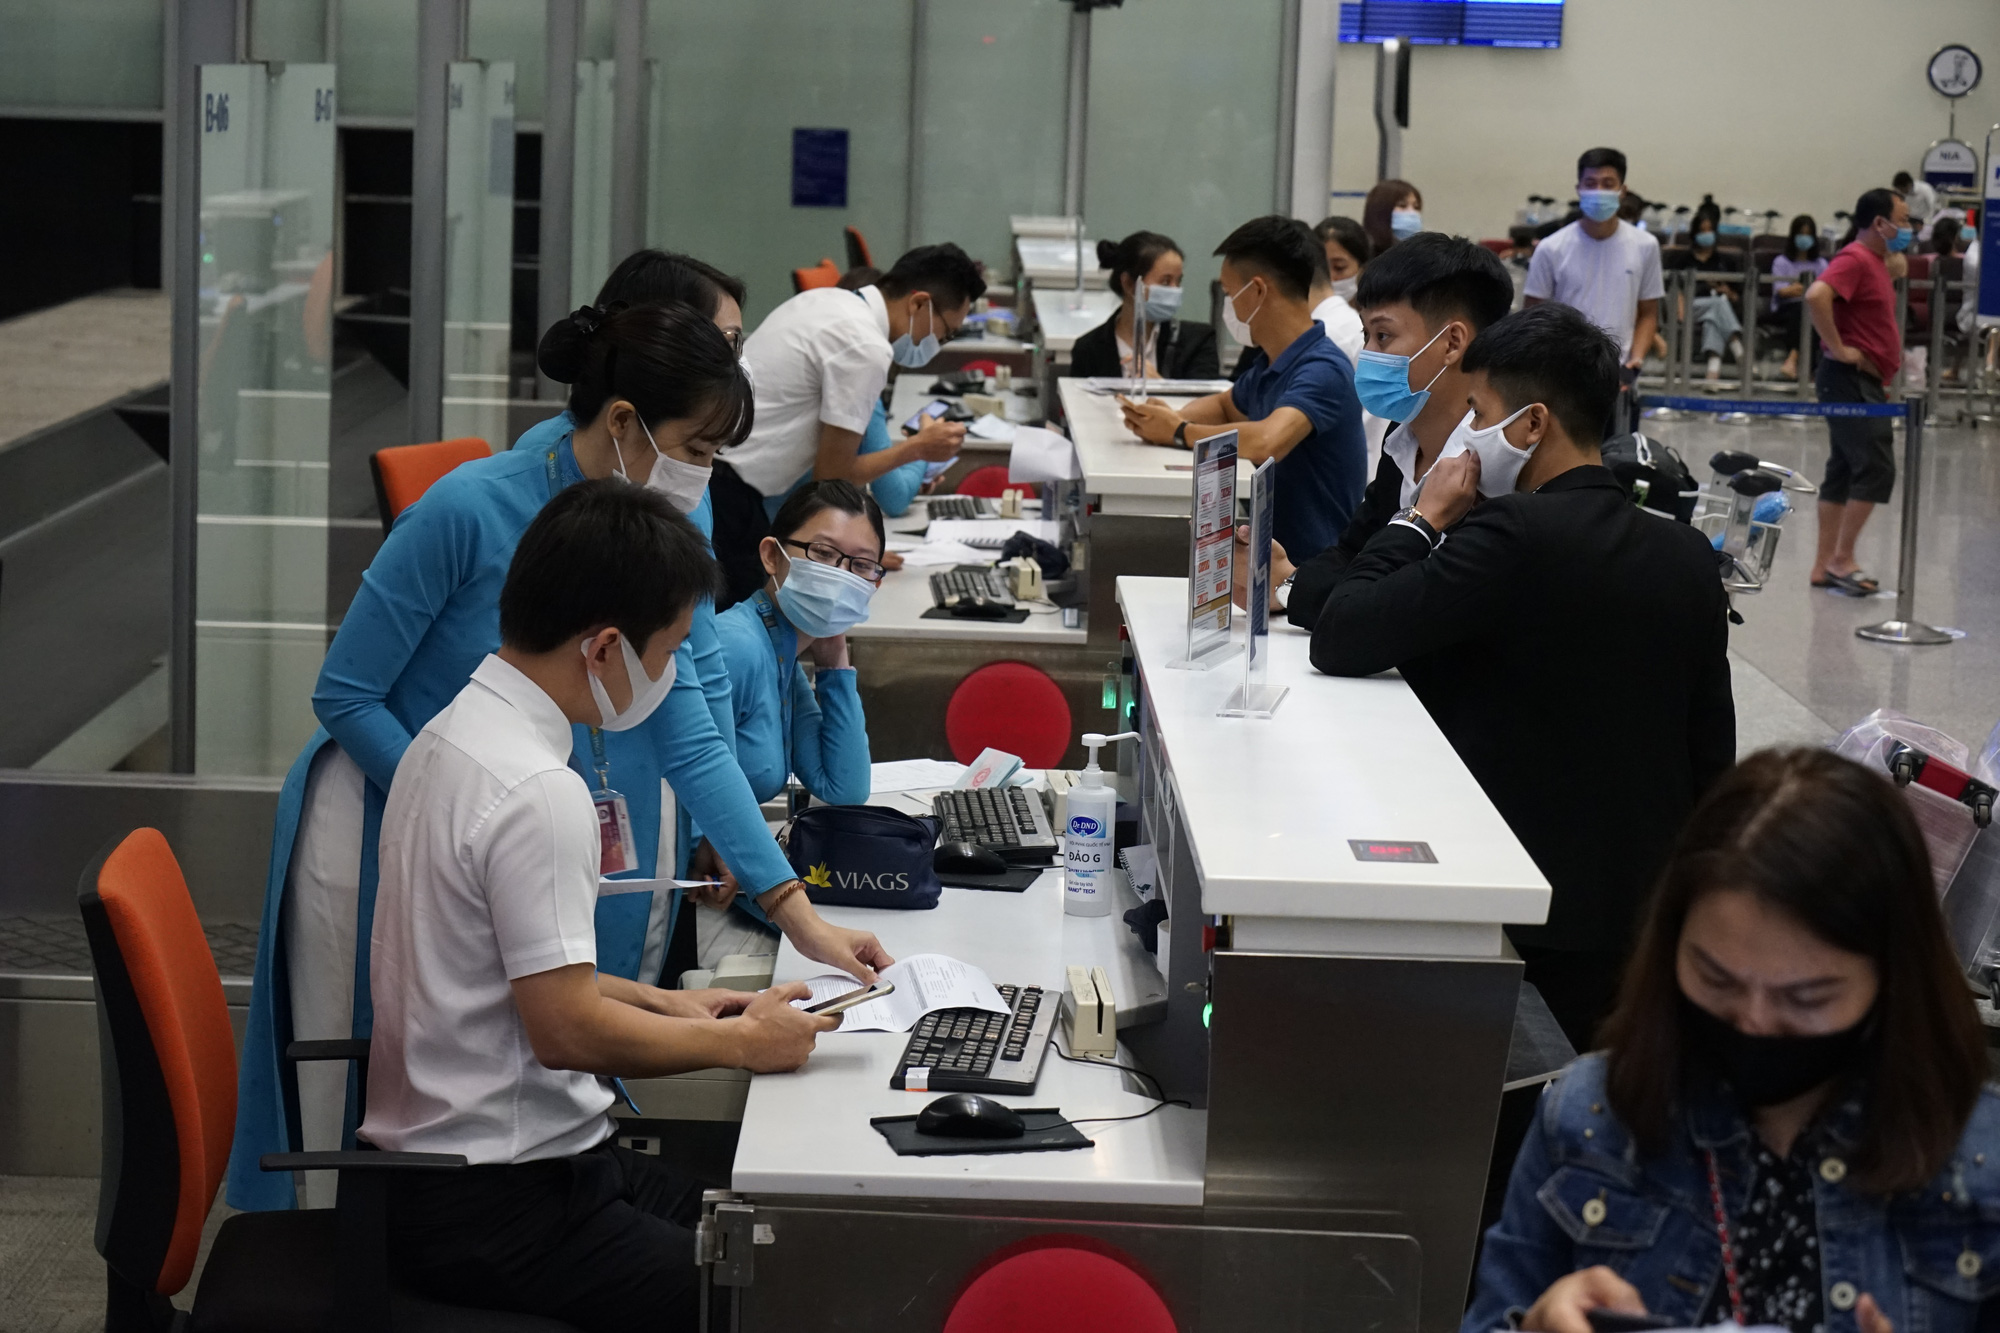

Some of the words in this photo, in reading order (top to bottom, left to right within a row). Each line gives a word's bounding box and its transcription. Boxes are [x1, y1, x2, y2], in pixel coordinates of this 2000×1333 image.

[1069, 850, 1090, 863] ĐẢO
[1093, 853, 1101, 863] G
[836, 871, 909, 891] VIAGS
